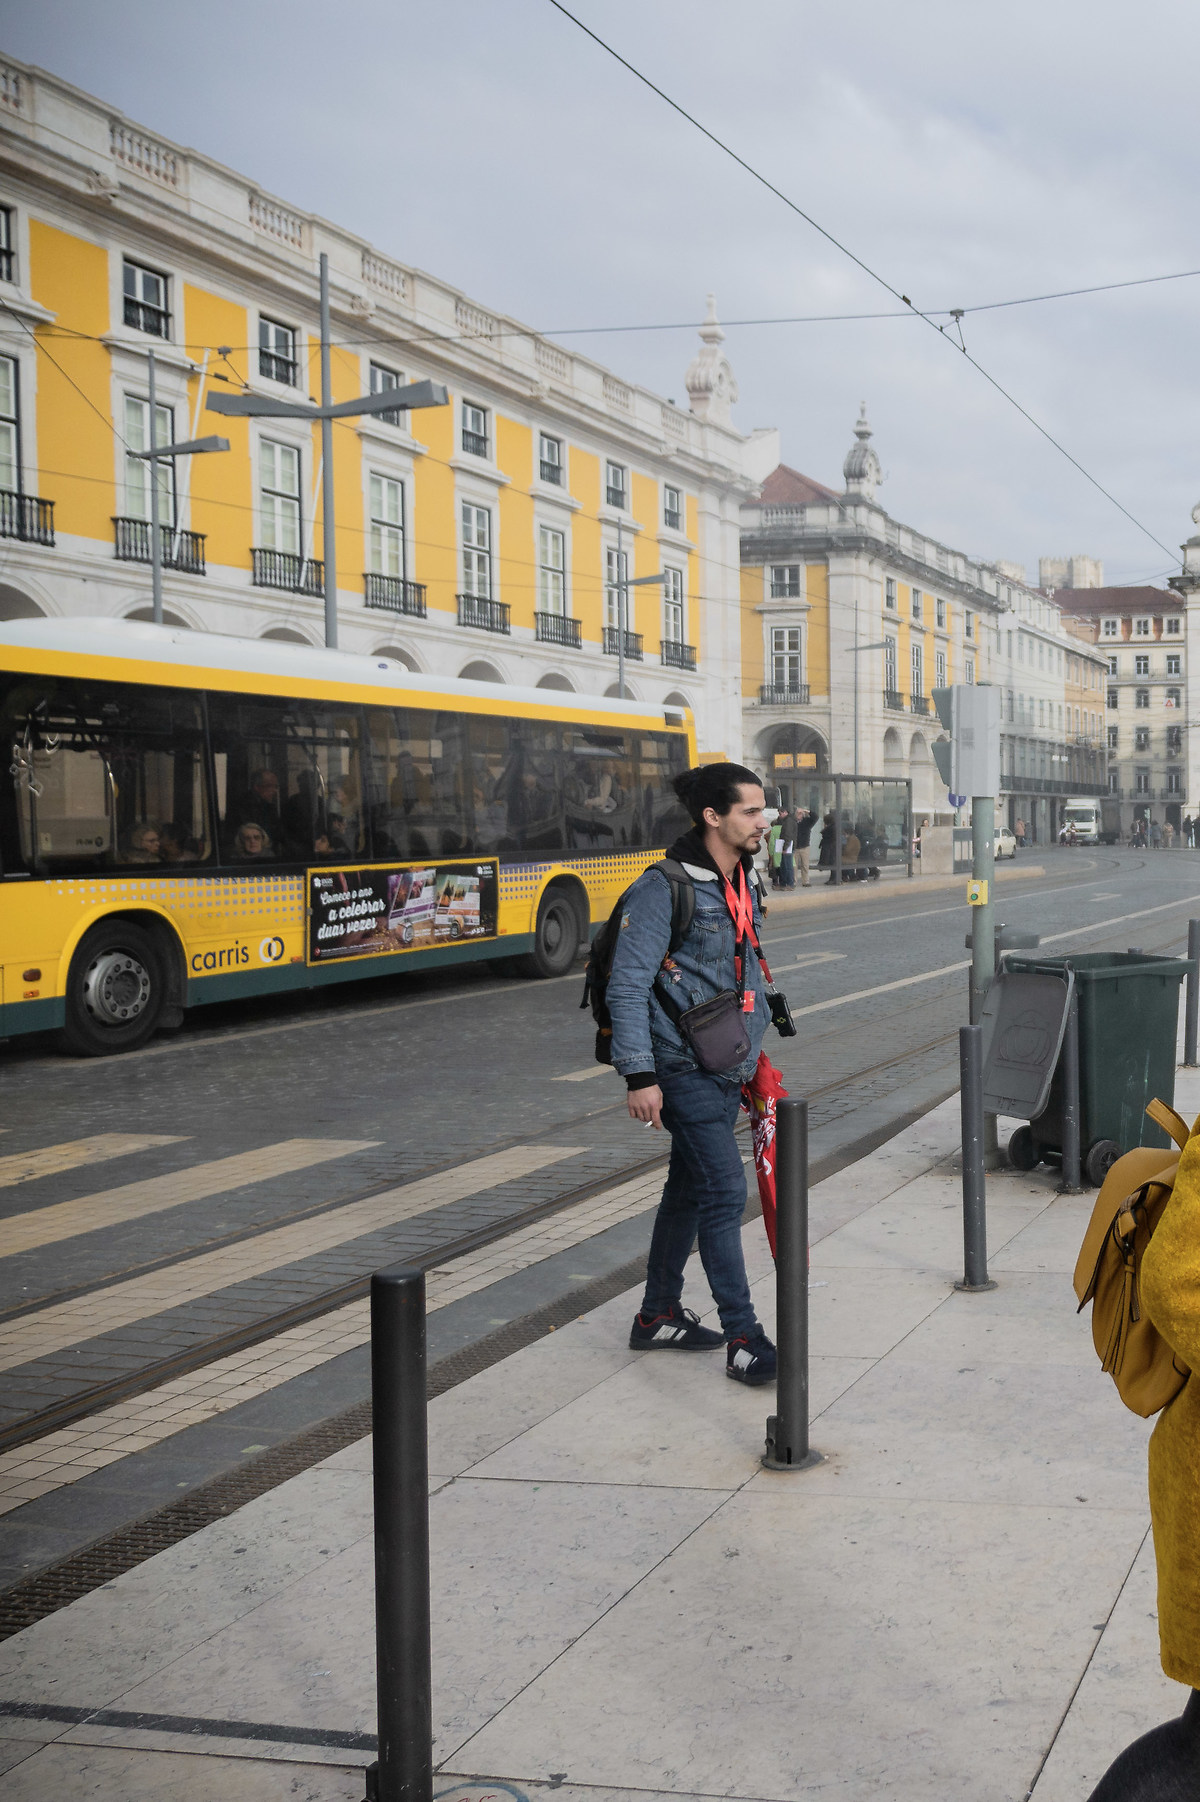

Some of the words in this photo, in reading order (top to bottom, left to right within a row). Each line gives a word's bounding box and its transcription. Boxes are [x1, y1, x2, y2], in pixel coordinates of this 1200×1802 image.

[320, 891, 351, 905] Comece
[358, 887, 373, 898] ano
[328, 909, 338, 921] a
[339, 898, 386, 919] celebrar
[317, 923, 346, 940] duas
[346, 917, 378, 934] vezes
[191, 940, 250, 972] carris
